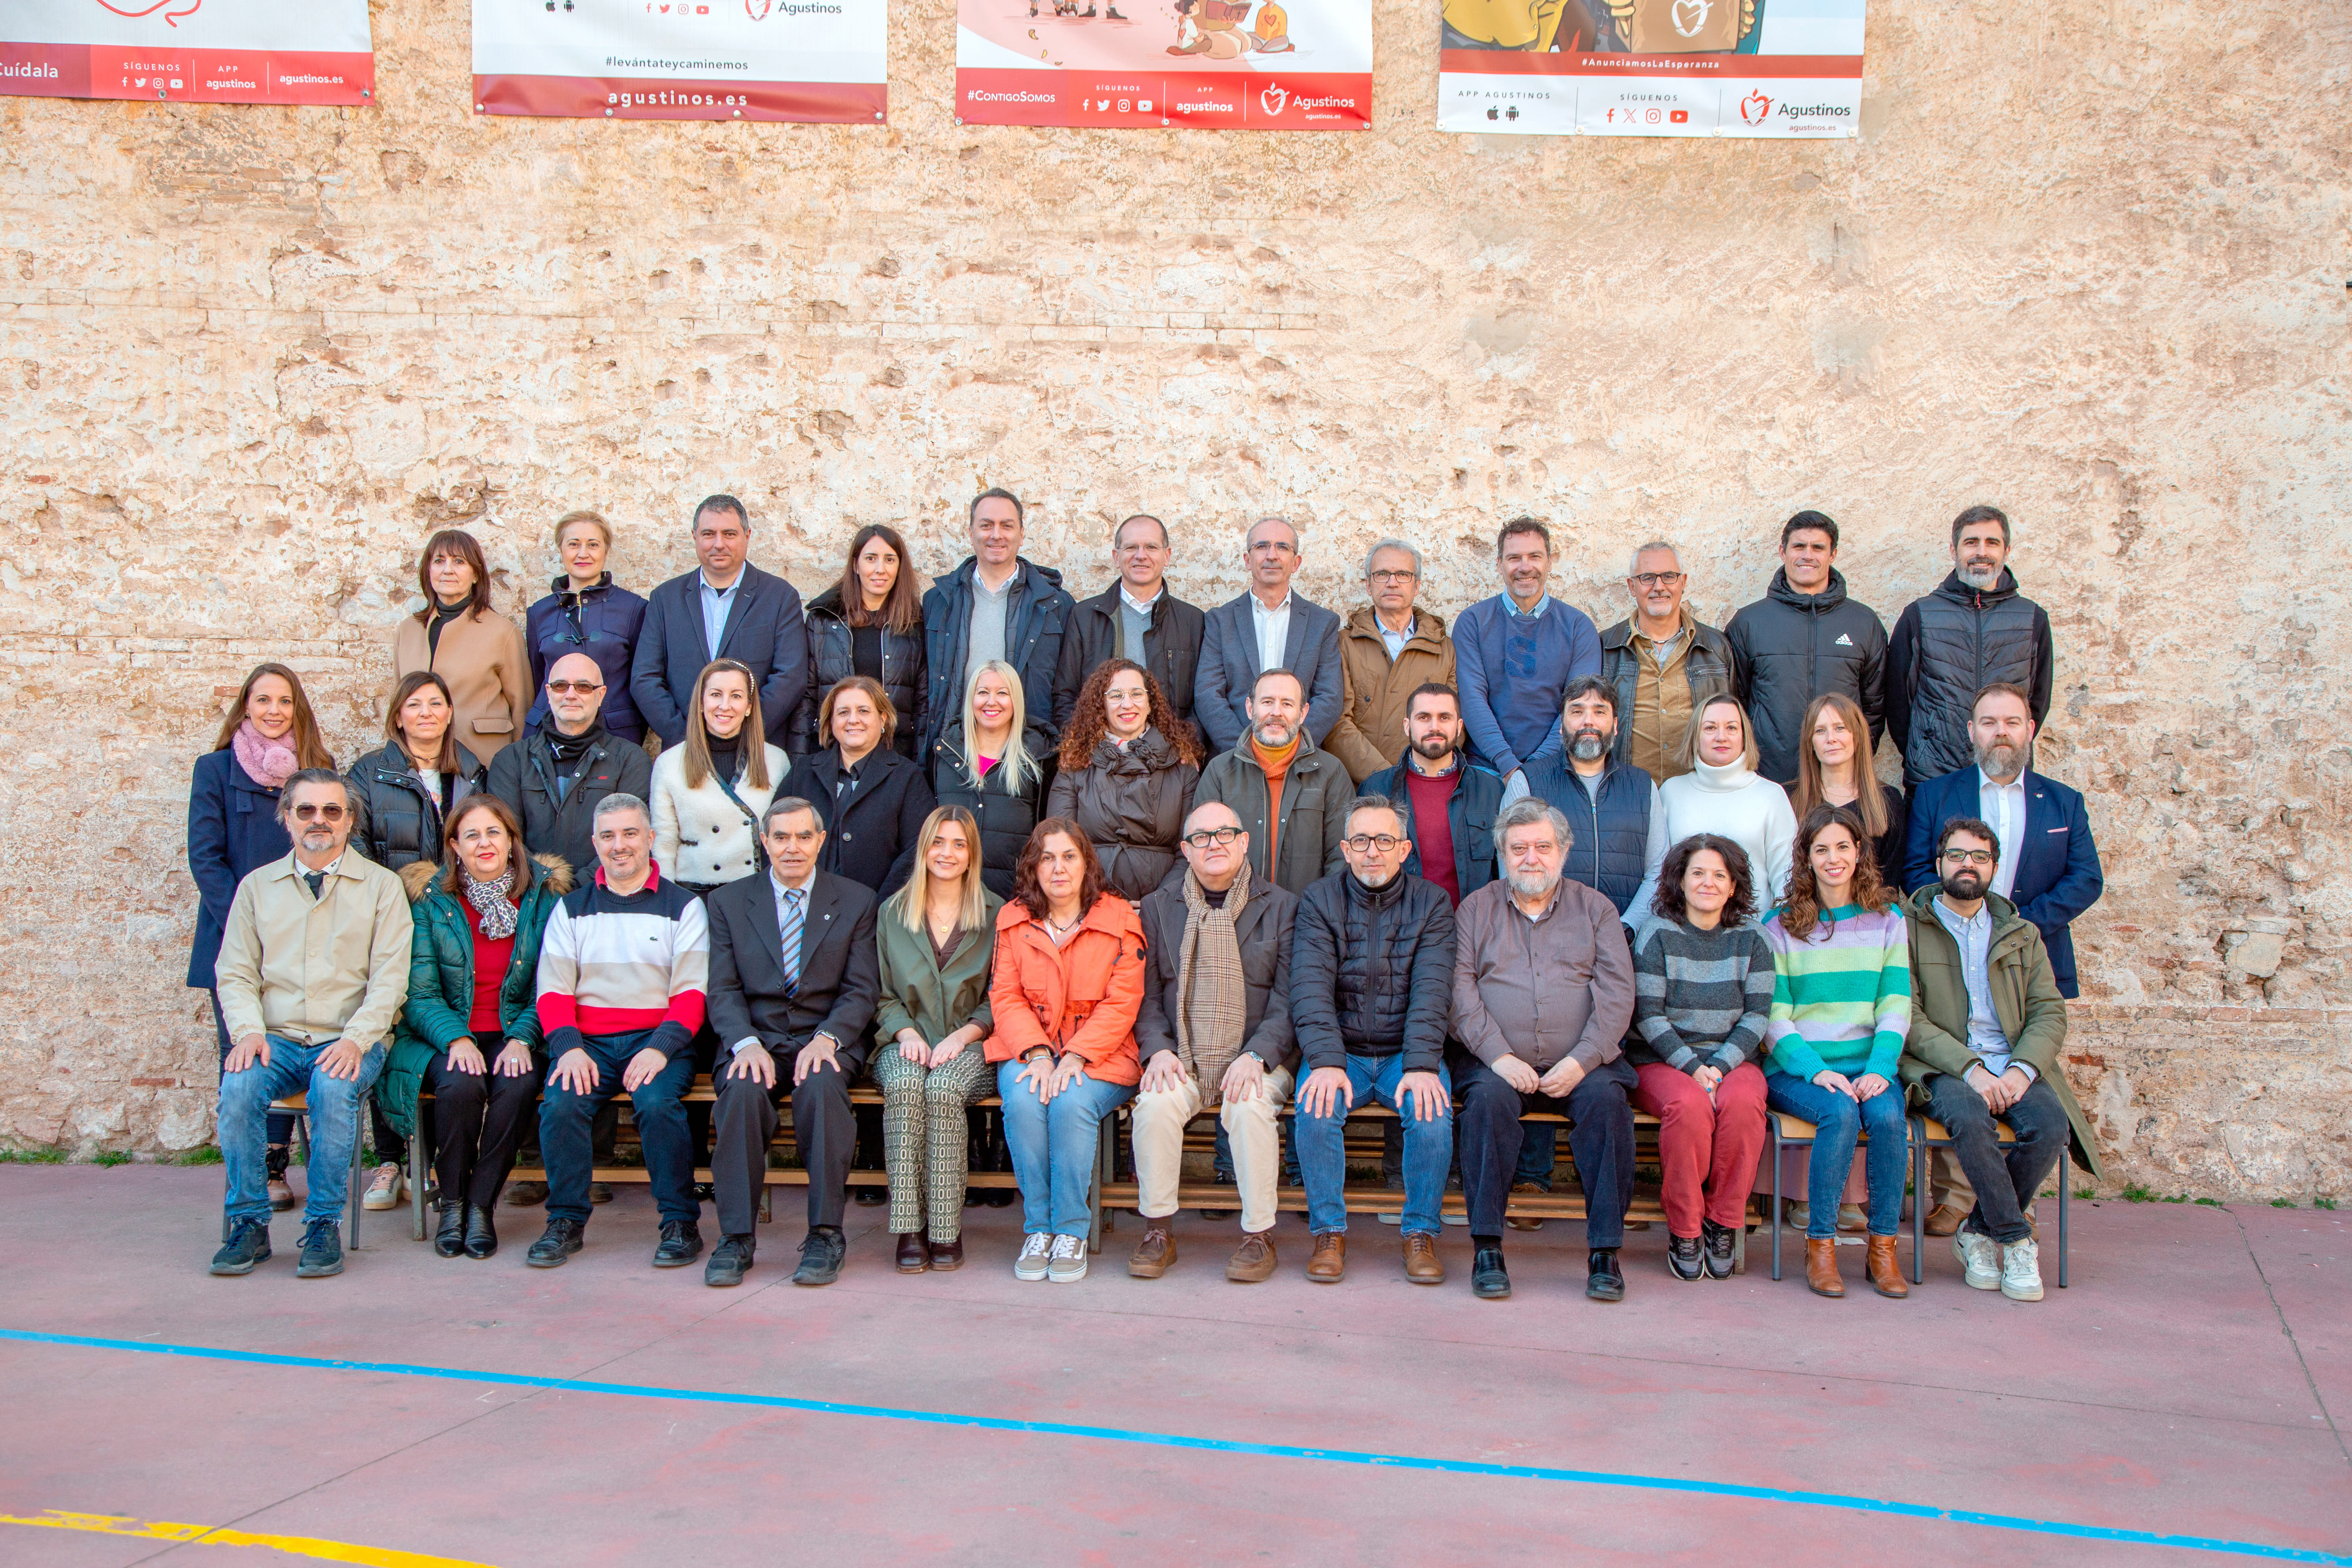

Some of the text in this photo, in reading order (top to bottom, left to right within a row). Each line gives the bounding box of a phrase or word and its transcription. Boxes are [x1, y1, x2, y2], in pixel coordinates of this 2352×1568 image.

[778, 1, 842, 16] Agustinos
[123, 61, 180, 71] SÍGUENOS
[606, 56, 748, 71] #levántateycaminemos
[1582, 58, 1719, 70] #AnunciamosLaEsperanza
[206, 79, 256, 90] agustinos
[279, 73, 344, 85] agustinos.es
[608, 90, 747, 108] agustinos.es
[1293, 95, 1355, 107] Agustinos
[1620, 92, 1677, 101] SÍGUENOS
[1176, 101, 1233, 114] agustinos
[1778, 102, 1851, 119] Agustinos
[1789, 124, 1837, 133] agustinos.es
